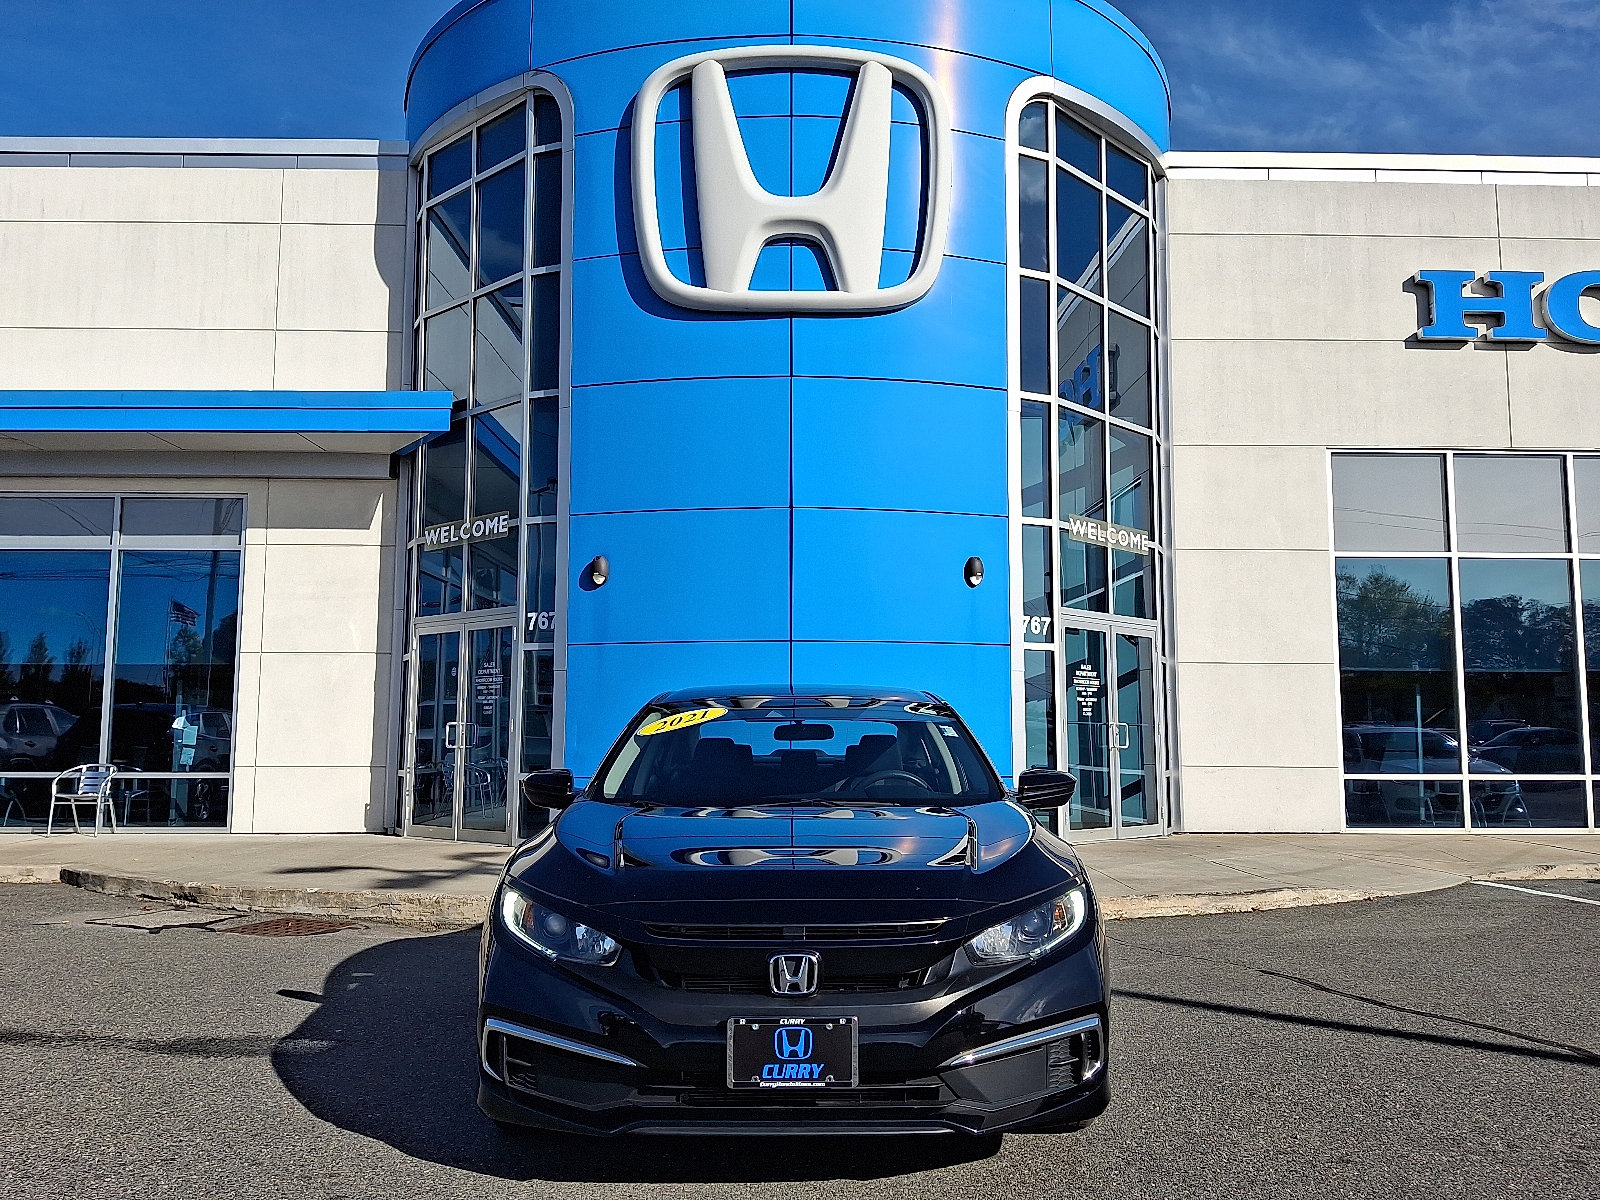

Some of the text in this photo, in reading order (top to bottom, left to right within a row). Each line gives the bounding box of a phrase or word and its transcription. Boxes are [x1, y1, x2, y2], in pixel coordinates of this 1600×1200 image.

[425, 515, 508, 546] WELCOME
[1069, 517, 1149, 551] WELCOME
[527, 611, 557, 631] 767
[1022, 616, 1051, 636] 767
[655, 709, 710, 732] 2021
[762, 1064, 824, 1078] CURRY
